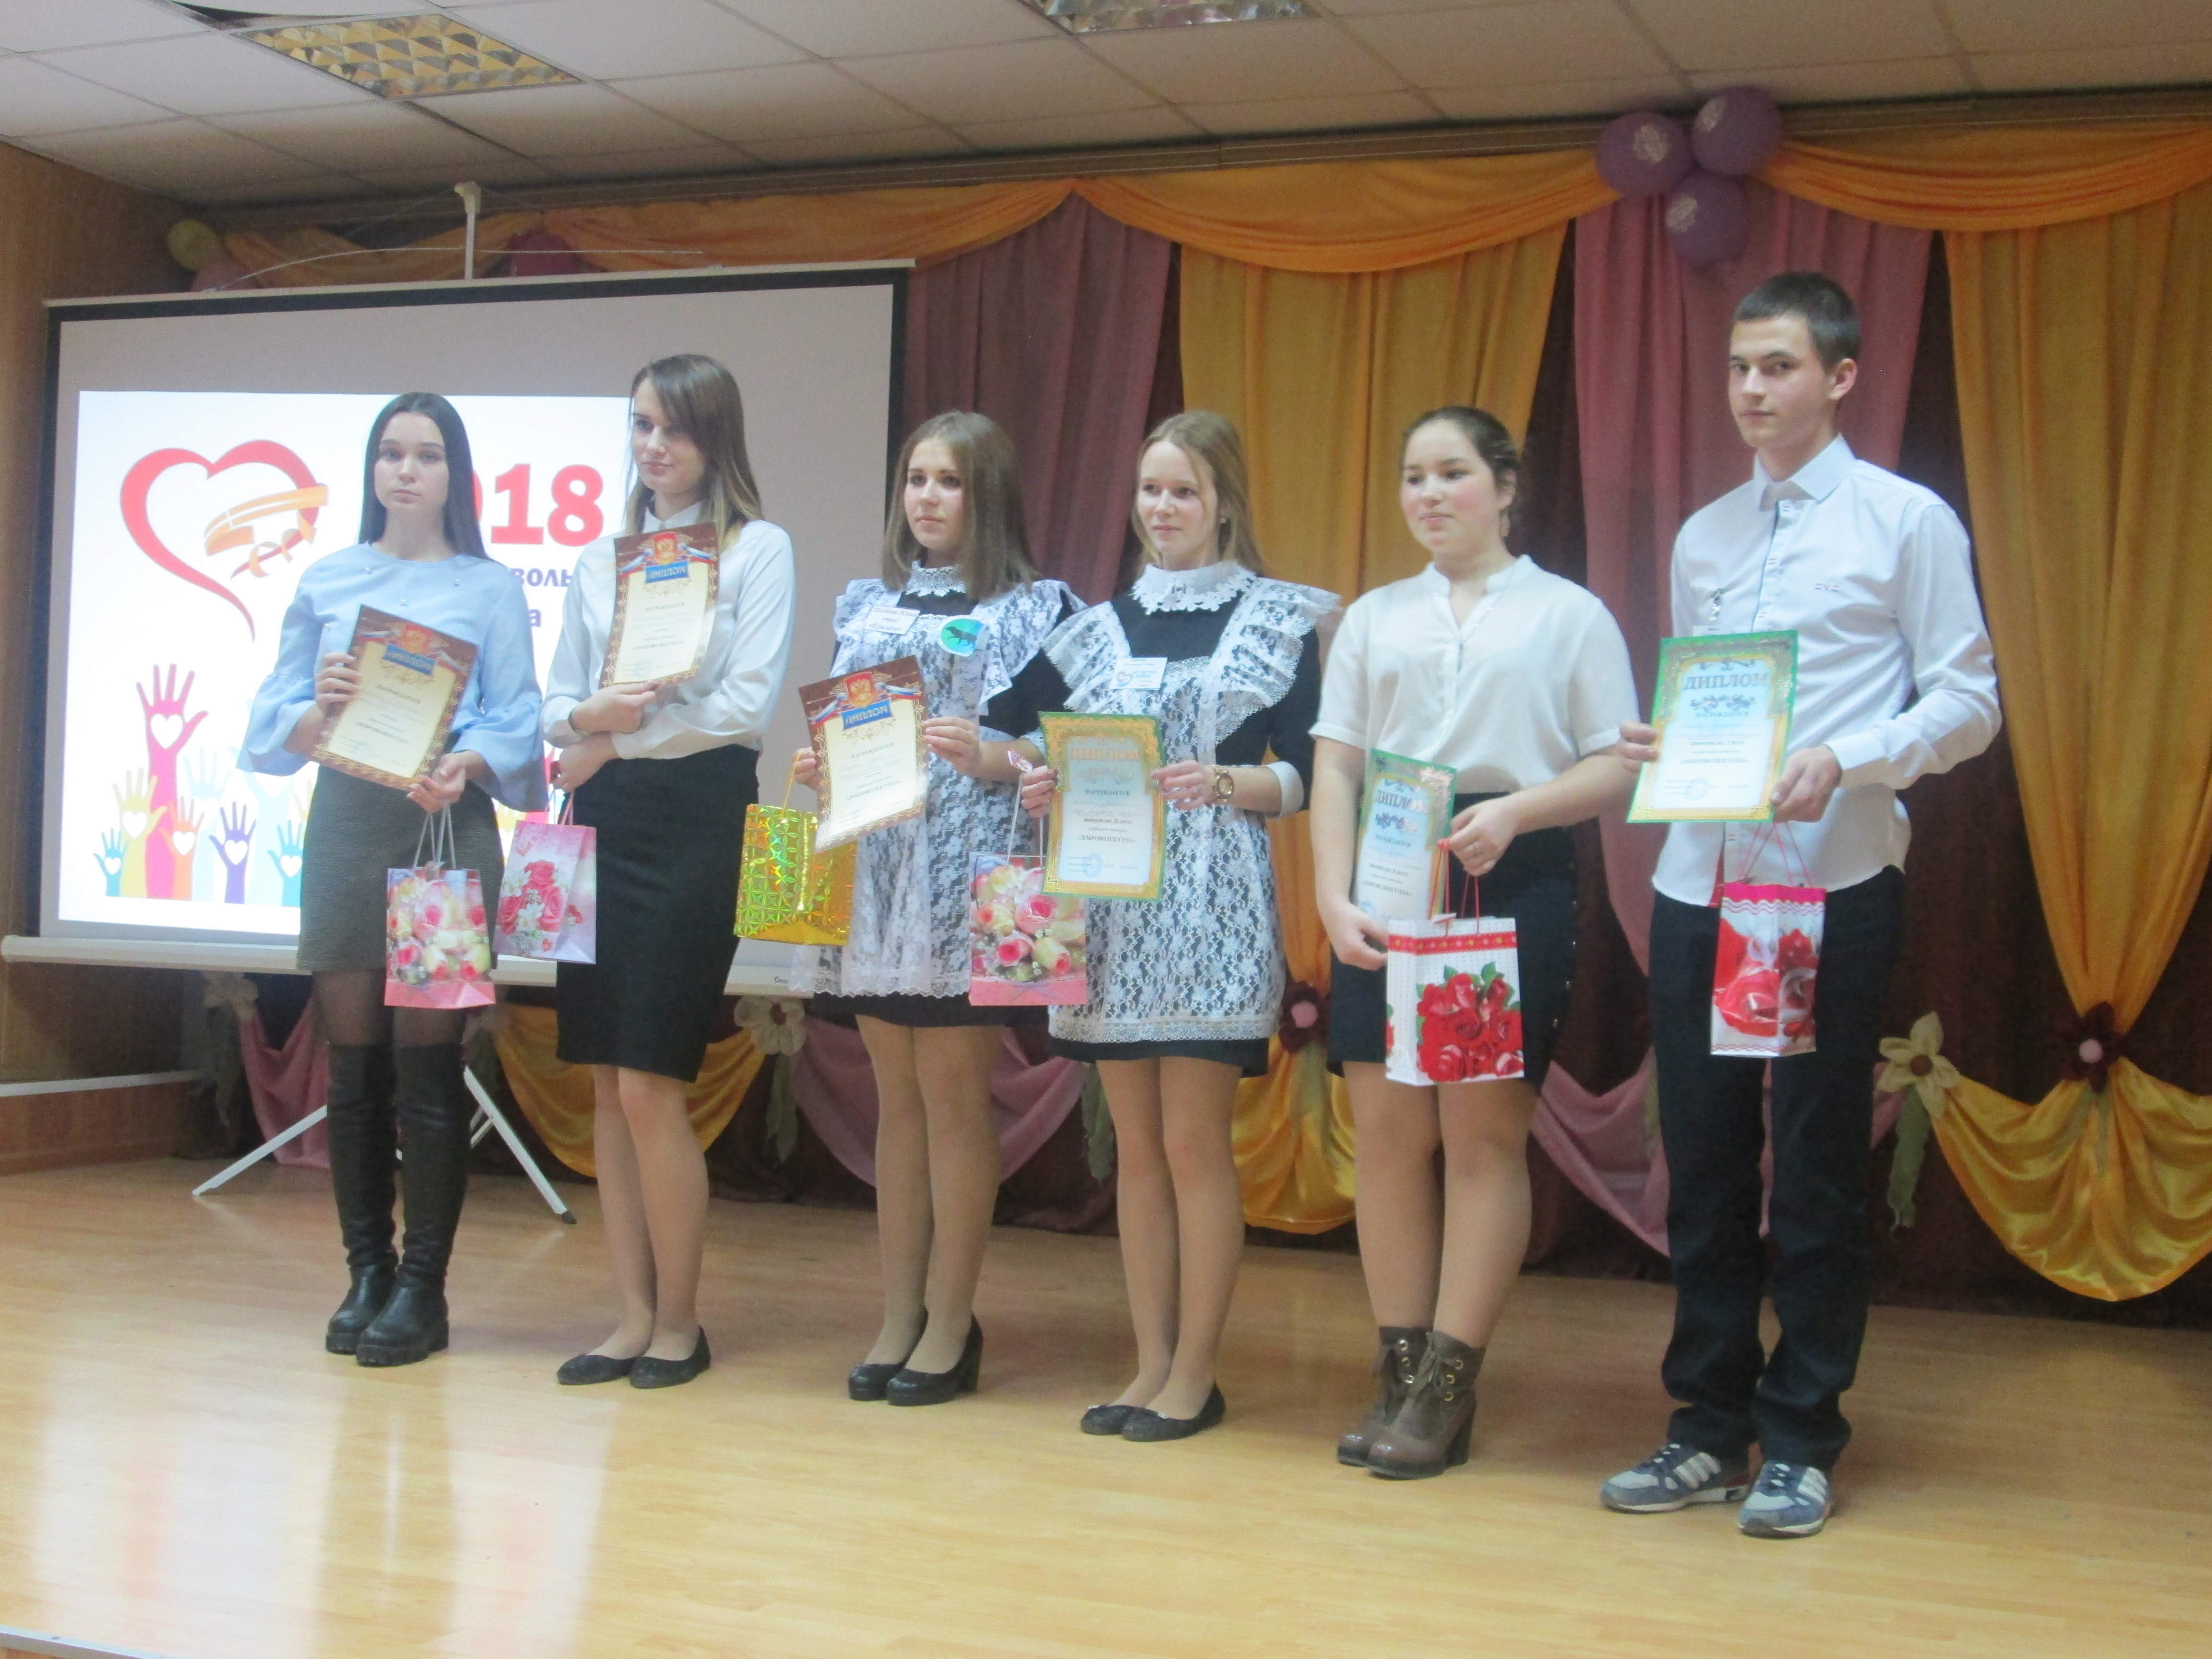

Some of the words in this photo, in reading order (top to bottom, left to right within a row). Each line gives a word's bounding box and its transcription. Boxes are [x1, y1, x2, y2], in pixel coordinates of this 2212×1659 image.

[649, 566, 685, 579] ДИПЛОМ
[1684, 673, 1769, 690] ДИПЛОМ
[846, 705, 888, 724] ДИПЛОМ
